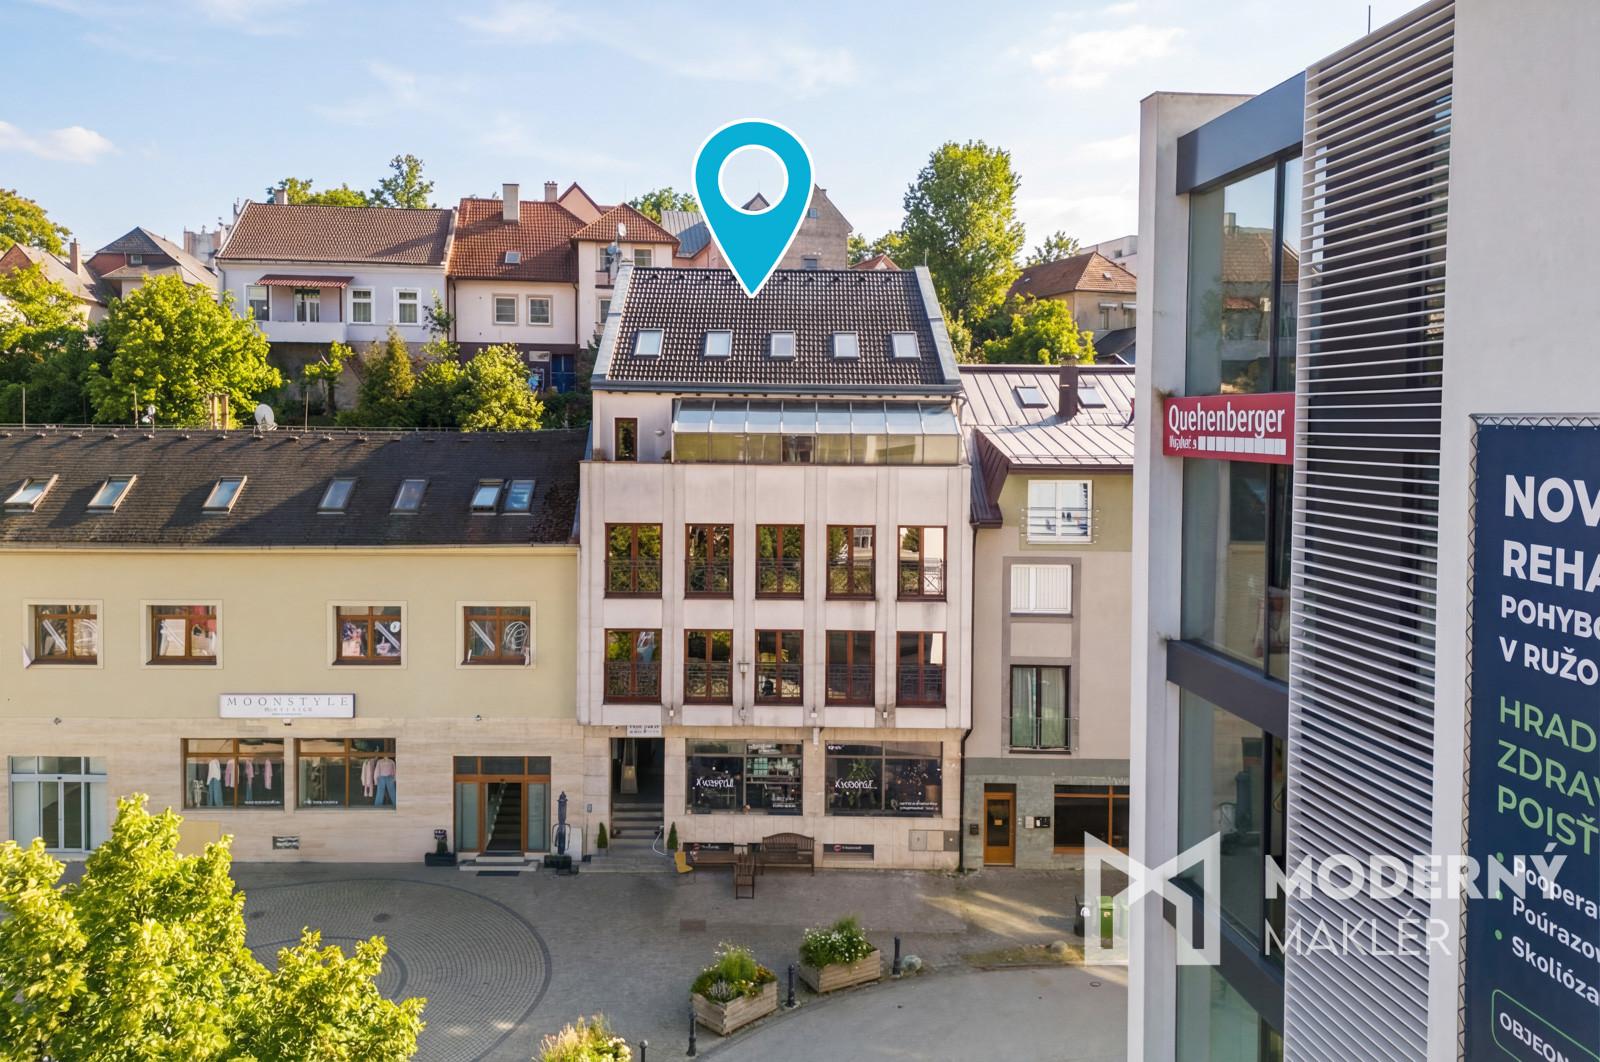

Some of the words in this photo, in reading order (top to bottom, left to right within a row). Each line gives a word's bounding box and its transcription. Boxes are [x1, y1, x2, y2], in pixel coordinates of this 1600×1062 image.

[1168, 401, 1286, 438] Quehenberger
[1499, 636, 1517, 663] V
[1523, 643, 1599, 686] RUŽO
[226, 696, 349, 707] MOONSTYLE
[1500, 696, 1597, 753] HRAD
[1498, 739, 1600, 807] ZDRA
[1498, 784, 1599, 855] POISŤ
[1513, 856, 1600, 920] Poopera
[1512, 936, 1600, 1006] Skolióza
